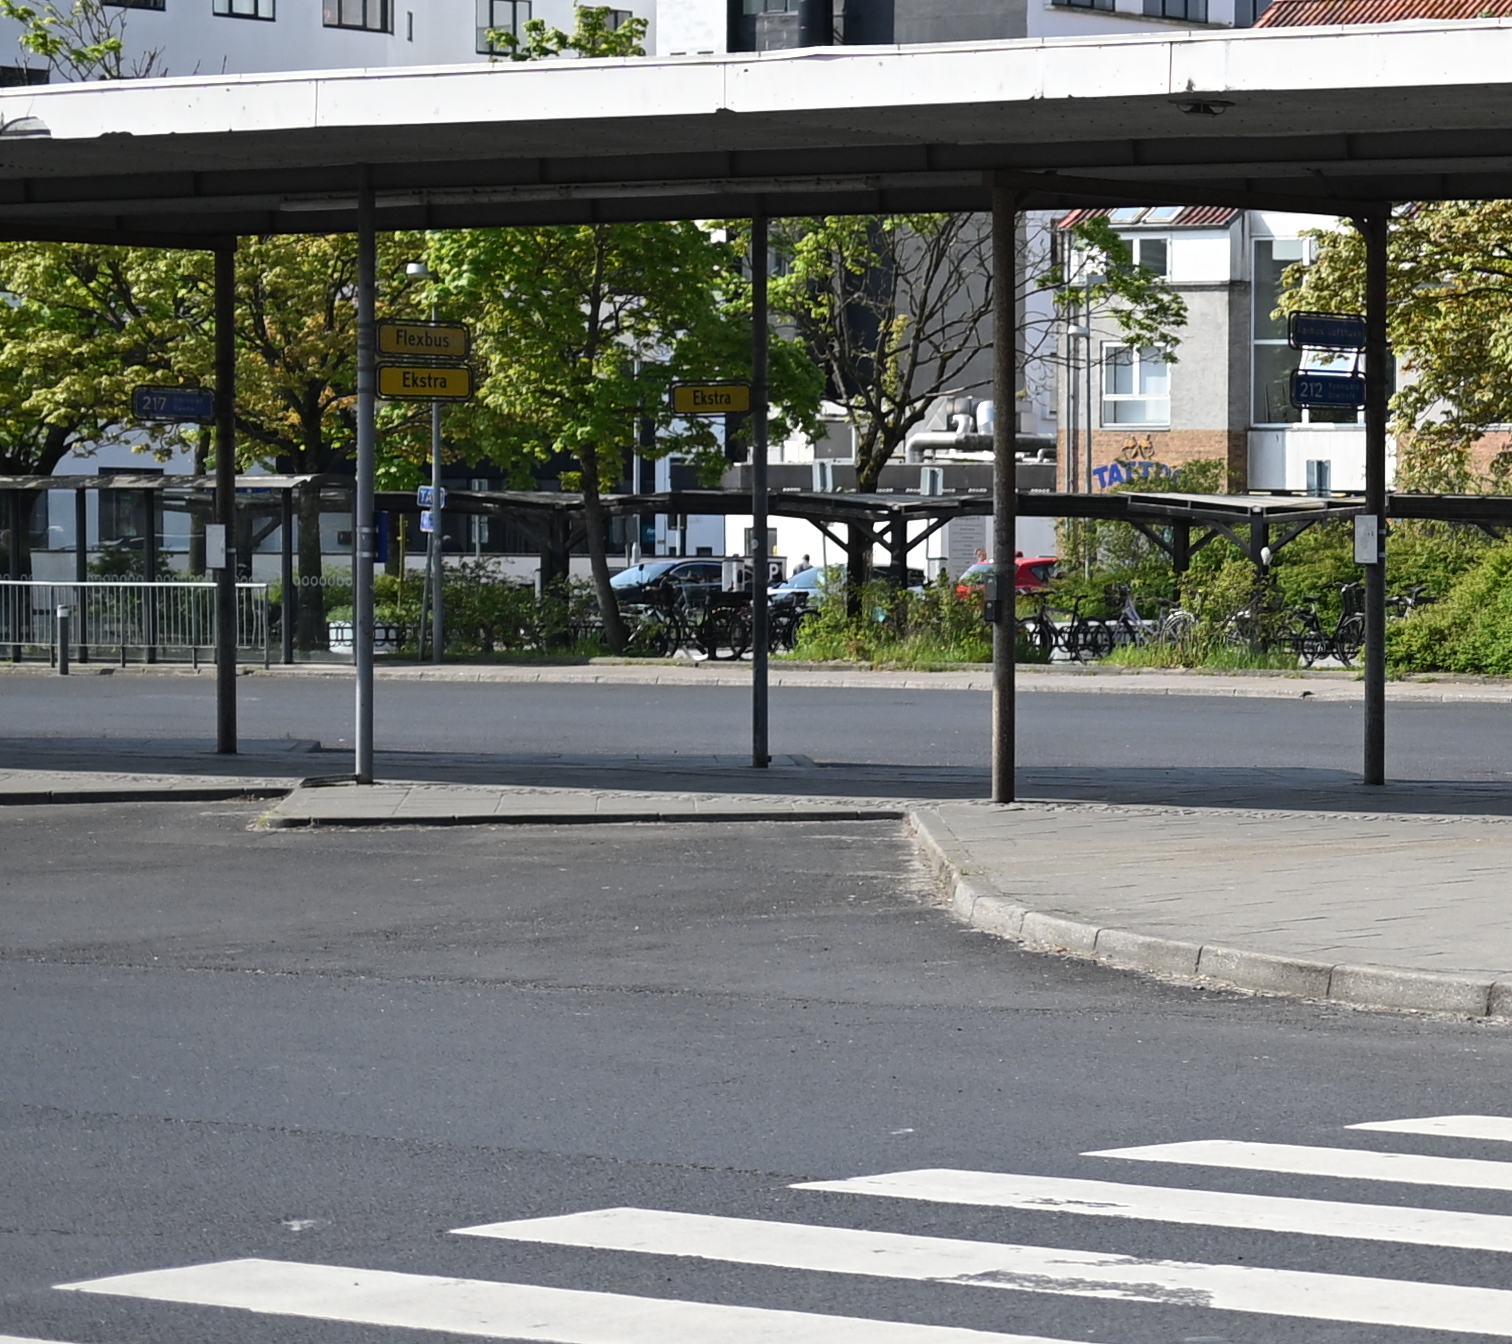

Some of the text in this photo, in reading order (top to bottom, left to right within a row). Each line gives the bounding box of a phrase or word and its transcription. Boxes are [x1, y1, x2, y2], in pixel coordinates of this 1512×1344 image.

[395, 329, 450, 348] Flexbus
[402, 371, 447, 389] Ekstra
[693, 390, 732, 406] Ekstra
[1300, 381, 1323, 398] 212
[142, 396, 167, 411] 217
